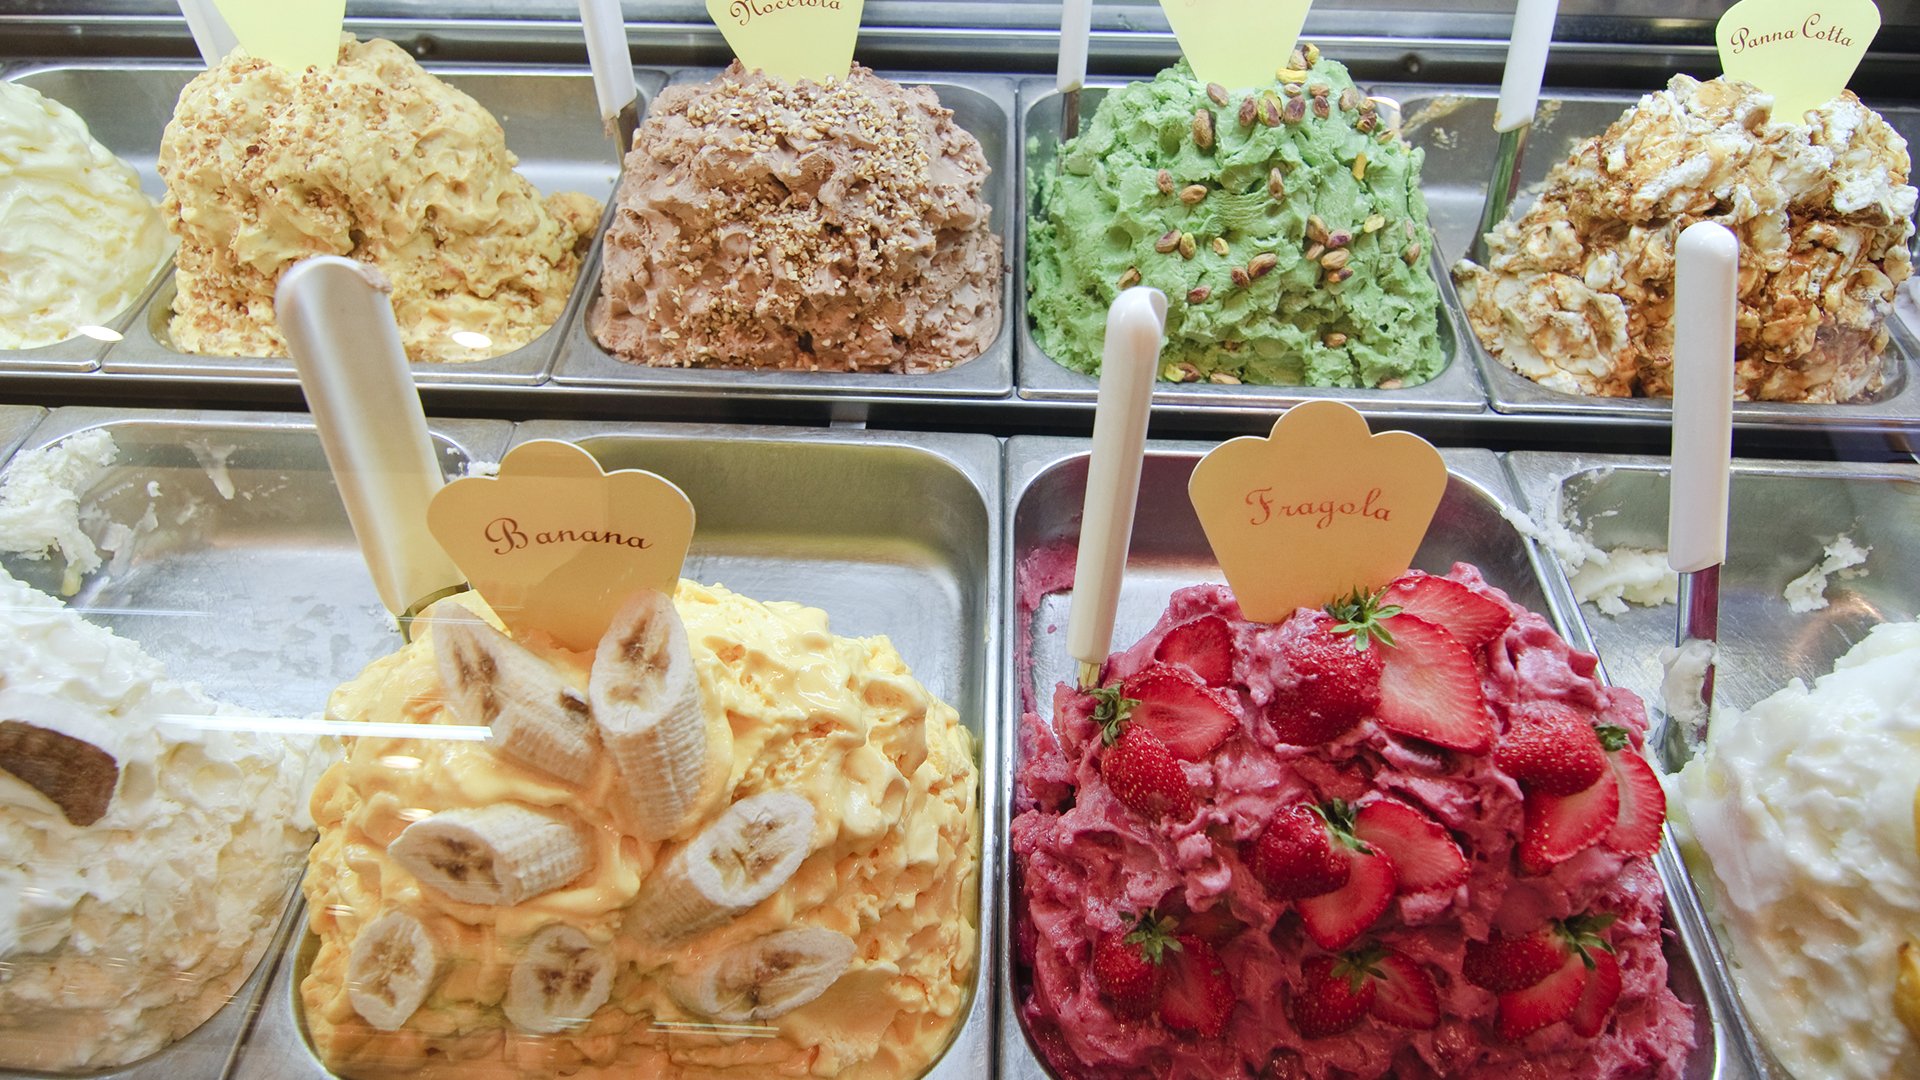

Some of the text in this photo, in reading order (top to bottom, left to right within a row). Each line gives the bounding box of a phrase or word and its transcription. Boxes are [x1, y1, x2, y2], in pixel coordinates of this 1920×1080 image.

[1730, 13, 1855, 54] Panna Cotta
[1245, 487, 1393, 529] Fragola
[484, 517, 653, 555] Banana
